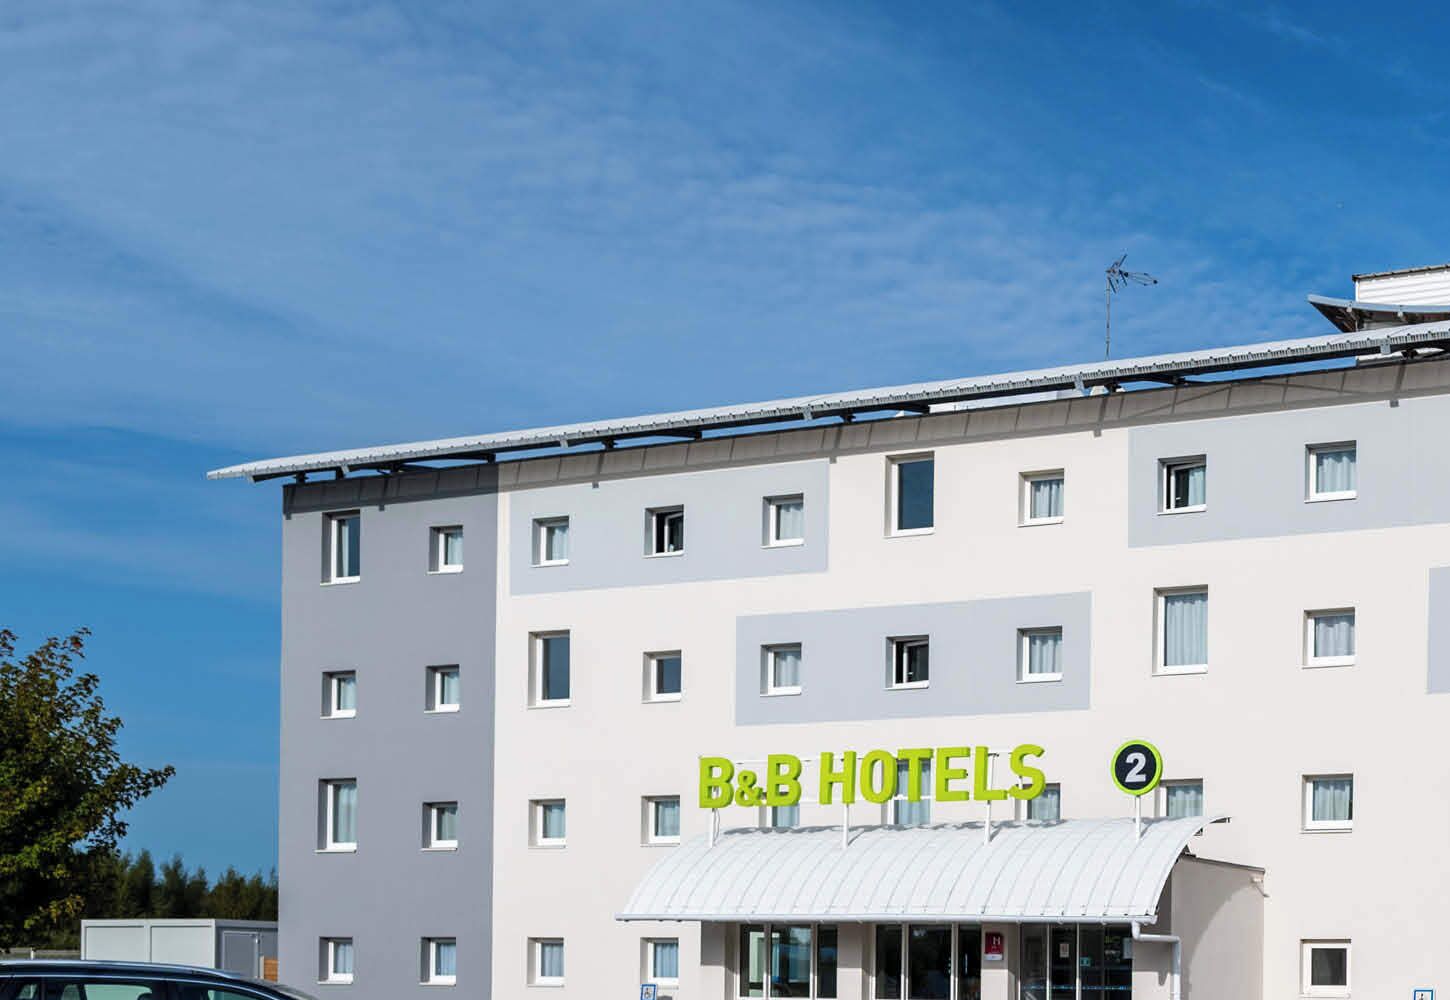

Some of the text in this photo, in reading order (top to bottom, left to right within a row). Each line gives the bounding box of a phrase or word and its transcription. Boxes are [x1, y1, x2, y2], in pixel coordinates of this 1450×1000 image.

[698, 744, 1046, 809] B&B HOTELS
[1125, 752, 1146, 783] 2
